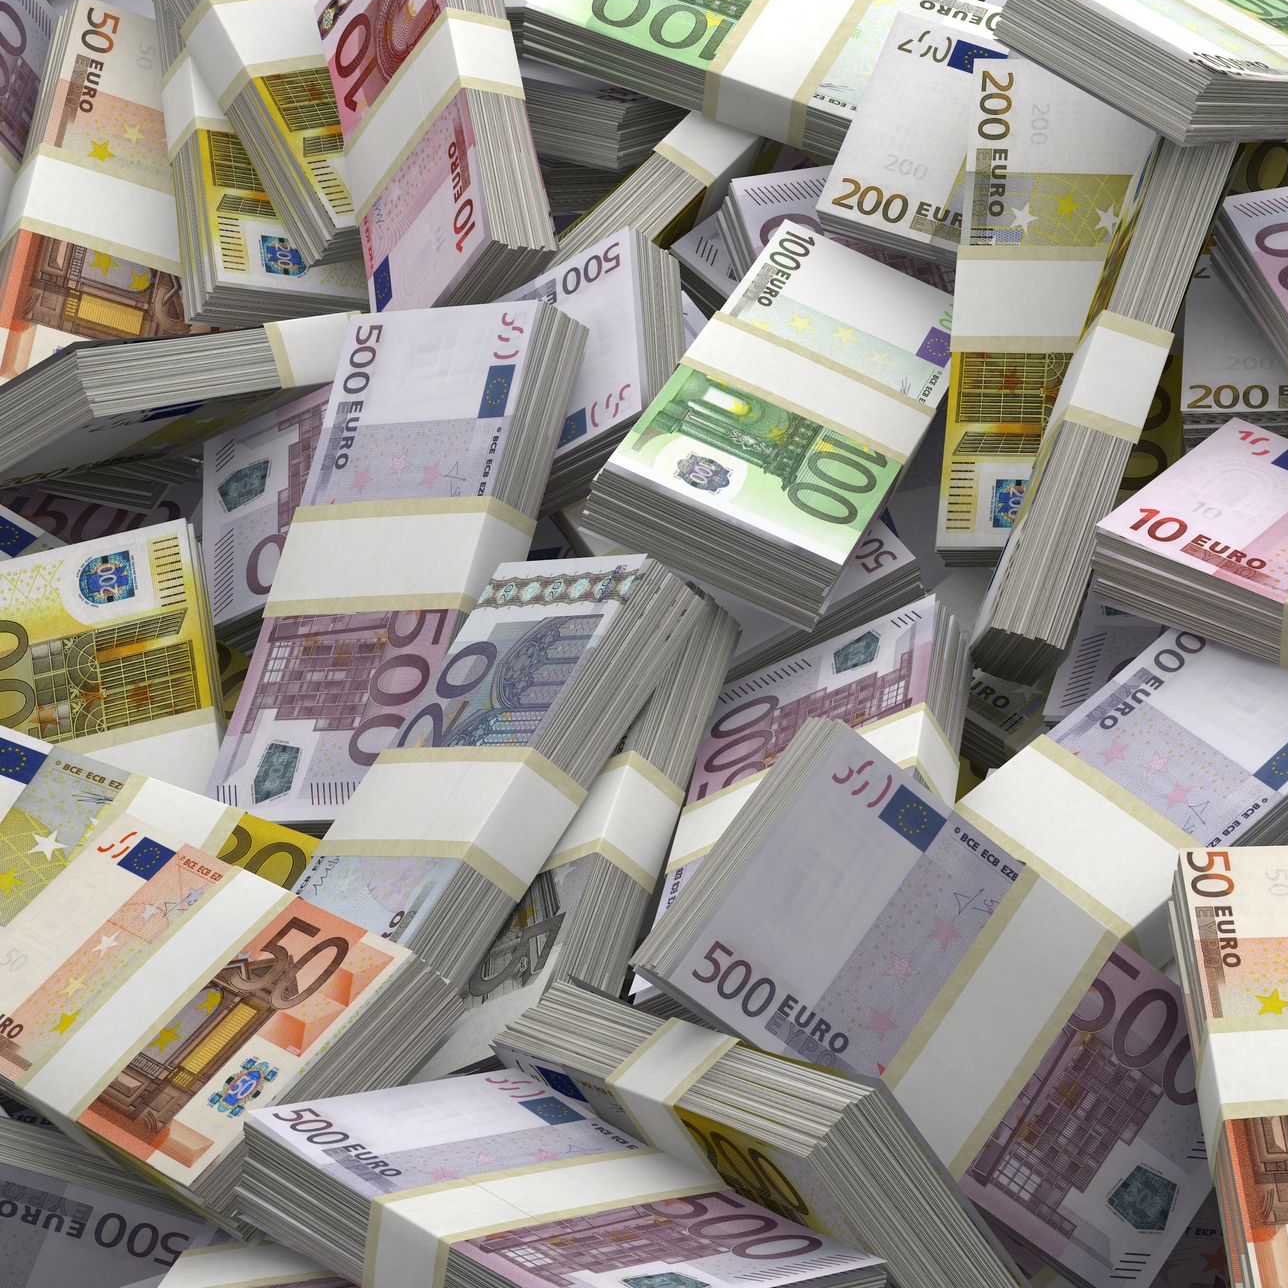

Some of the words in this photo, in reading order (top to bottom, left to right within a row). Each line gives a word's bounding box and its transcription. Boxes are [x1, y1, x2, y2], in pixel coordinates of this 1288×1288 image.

[82, 6, 120, 54] 50
[78, 60, 104, 113] EURO
[338, 14, 372, 110] 10
[981, 71, 1013, 140] 200
[448, 142, 467, 194] EURO
[990, 149, 1008, 217] EURO
[454, 199, 476, 253] 10
[832, 177, 909, 223] 200
[769, 230, 814, 269] 100
[758, 269, 792, 308] EURO
[343, 324, 383, 394] 500
[1187, 384, 1268, 409] 200
[333, 400, 364, 471] EURO
[787, 440, 889, 524] 100
[1128, 509, 1187, 541] 10
[1191, 535, 1267, 570] EURO
[99, 560, 117, 600] 200
[401, 641, 498, 748] 20
[959, 831, 981, 852] BCE
[980, 848, 1001, 868] ECB
[1000, 861, 1019, 882] EZB
[1187, 850, 1234, 899] 50
[1214, 906, 1241, 968] EURO
[229, 917, 349, 1010] 50
[691, 941, 777, 1018] 500
[776, 994, 850, 1055] EURO
[229, 1078, 256, 1098] 50
[272, 1107, 349, 1147] 500
[342, 1141, 403, 1177] EURO
